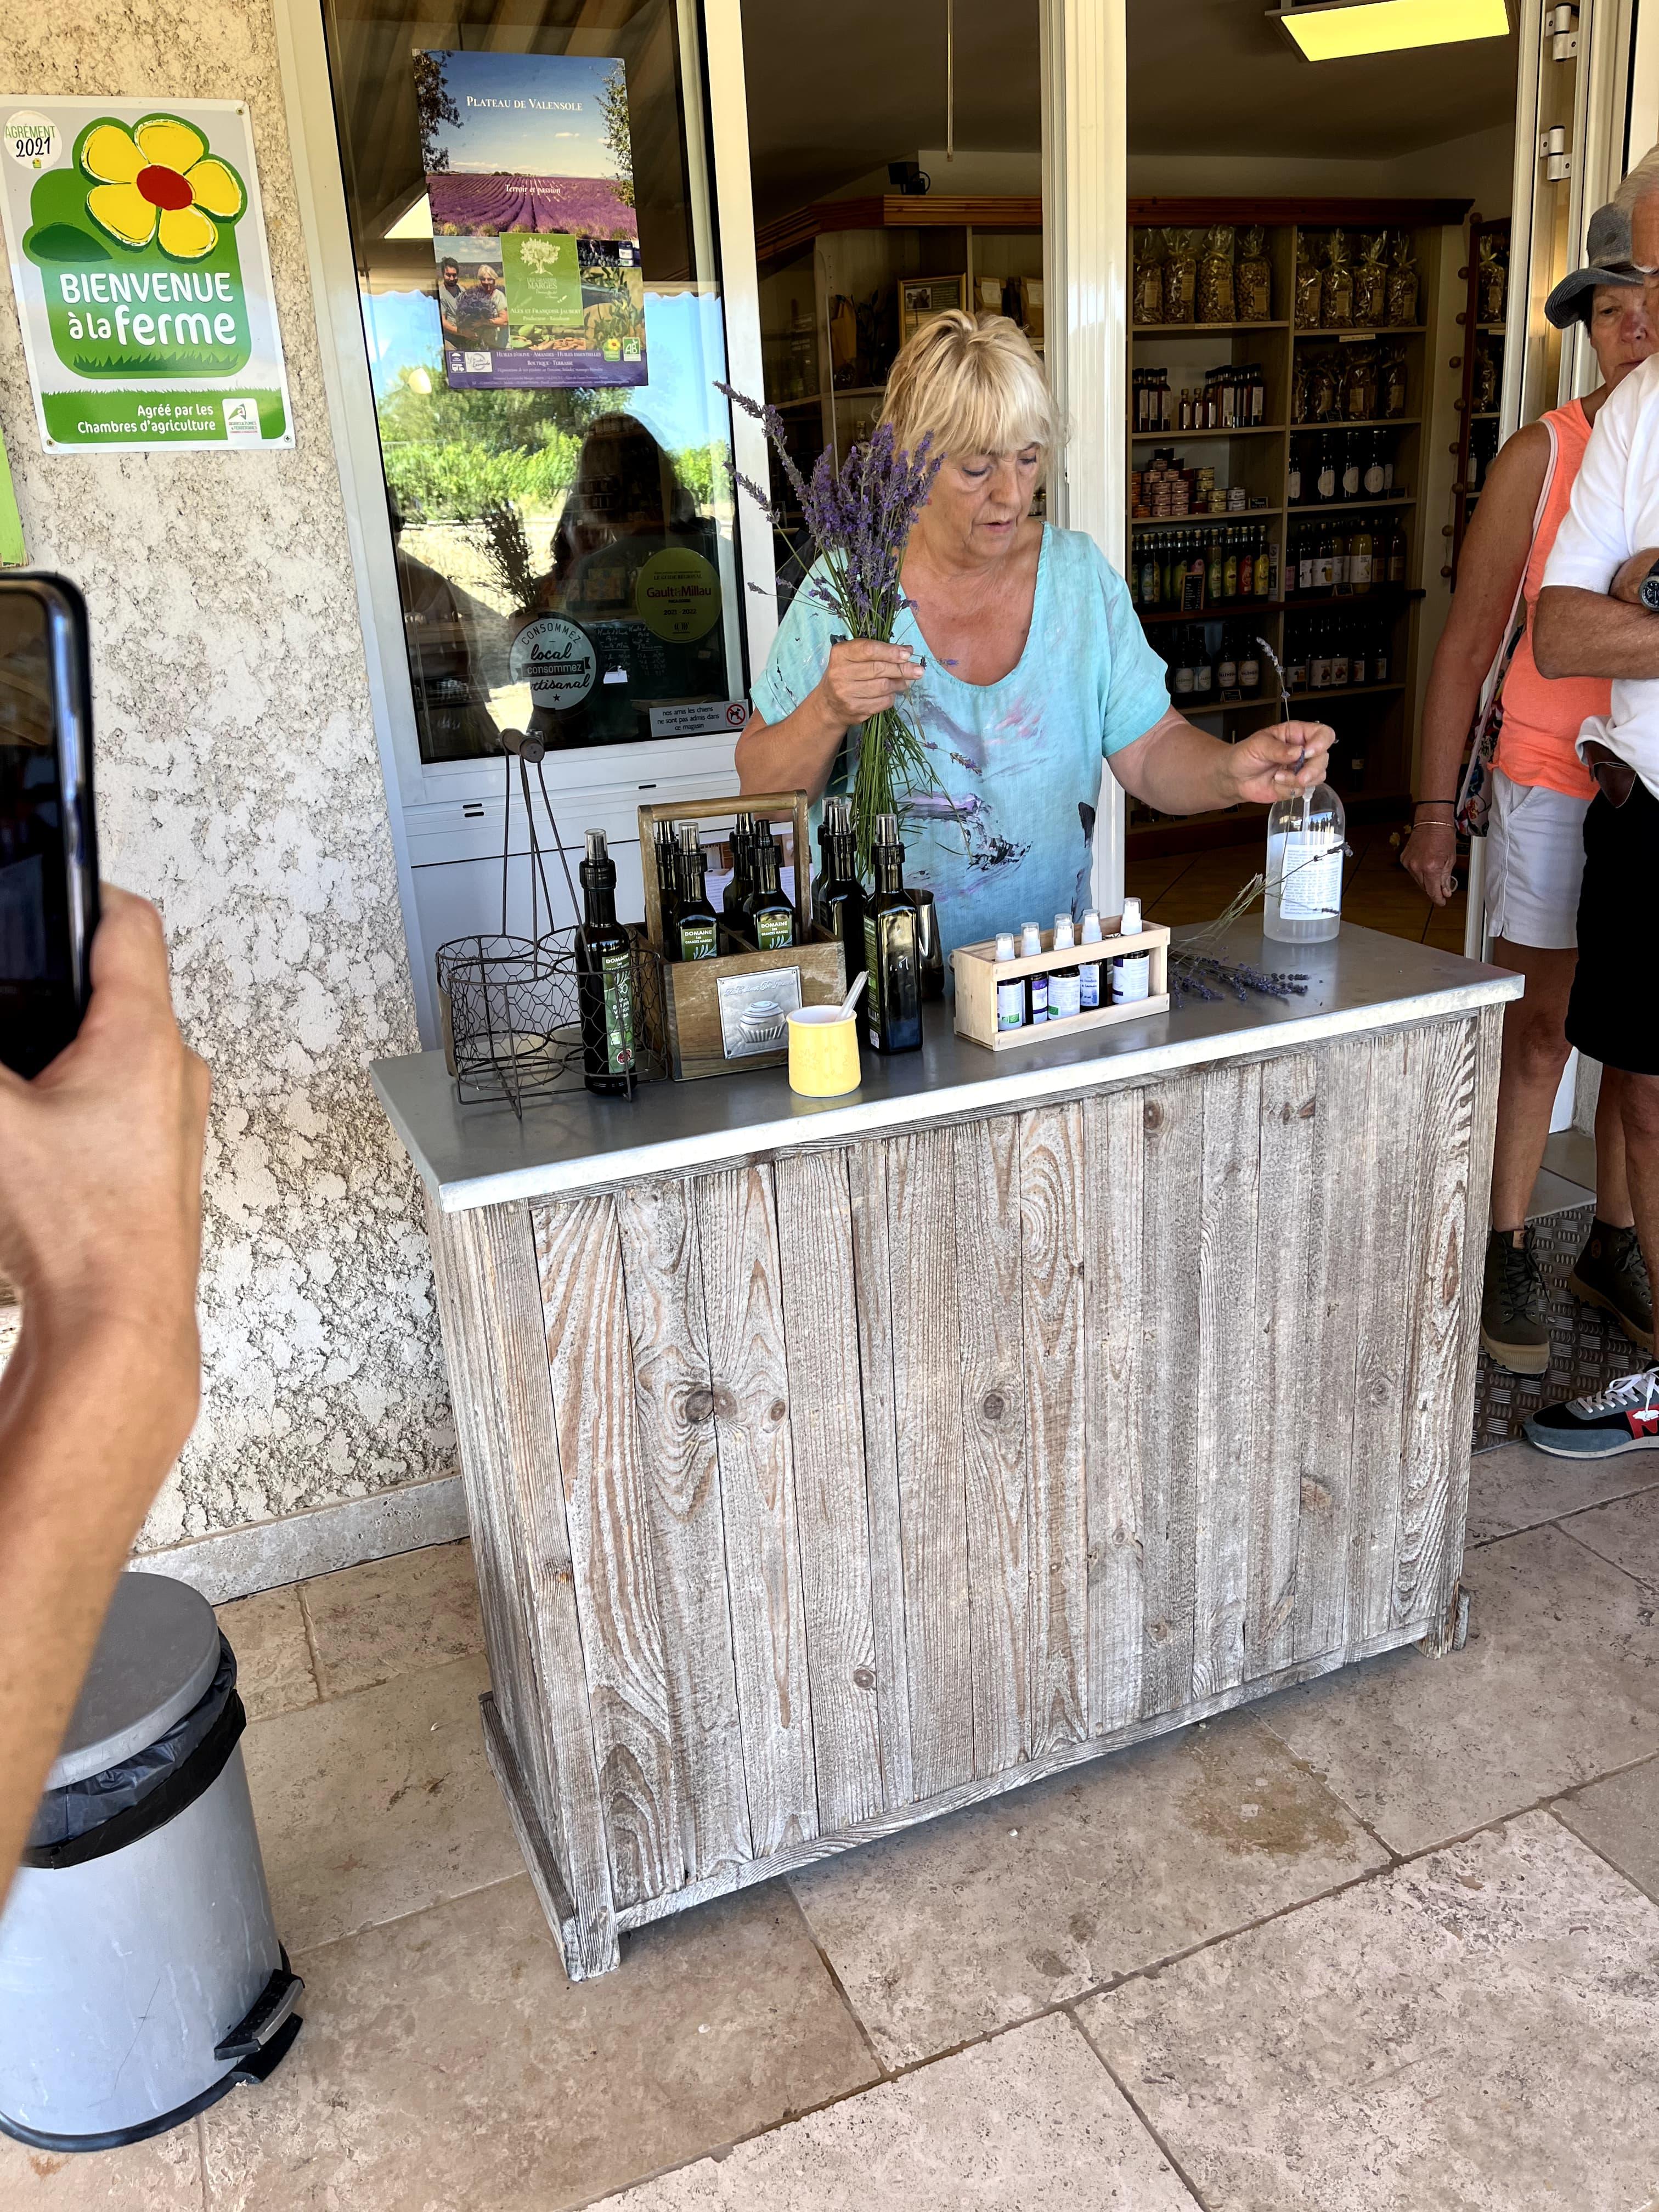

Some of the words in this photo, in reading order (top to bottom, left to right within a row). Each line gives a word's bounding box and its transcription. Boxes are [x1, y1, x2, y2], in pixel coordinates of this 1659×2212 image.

[466, 95, 511, 107] PLATEAU
[514, 100, 527, 109] DE
[528, 98, 583, 111] VALENSOLE
[5, 123, 55, 139] AGRÉMENT
[16, 136, 50, 157] 2021
[505, 183, 528, 193] Terroir
[537, 187, 561, 196] passion
[59, 272, 233, 303] BIENVENUE
[527, 281, 557, 290] MARGES
[67, 311, 83, 340] à
[86, 312, 112, 340] la
[114, 304, 236, 346] ferme
[625, 342, 637, 354] AB
[137, 403, 171, 419] Agréé
[174, 405, 193, 418] par
[196, 404, 213, 416] les
[77, 421, 137, 434] Chambres
[140, 419, 216, 434] d'agriculture
[521, 622, 582, 645] CONSOMMEZ
[531, 641, 573, 661] local
[527, 663, 583, 675] consommez
[531, 673, 591, 691] rtisanal
